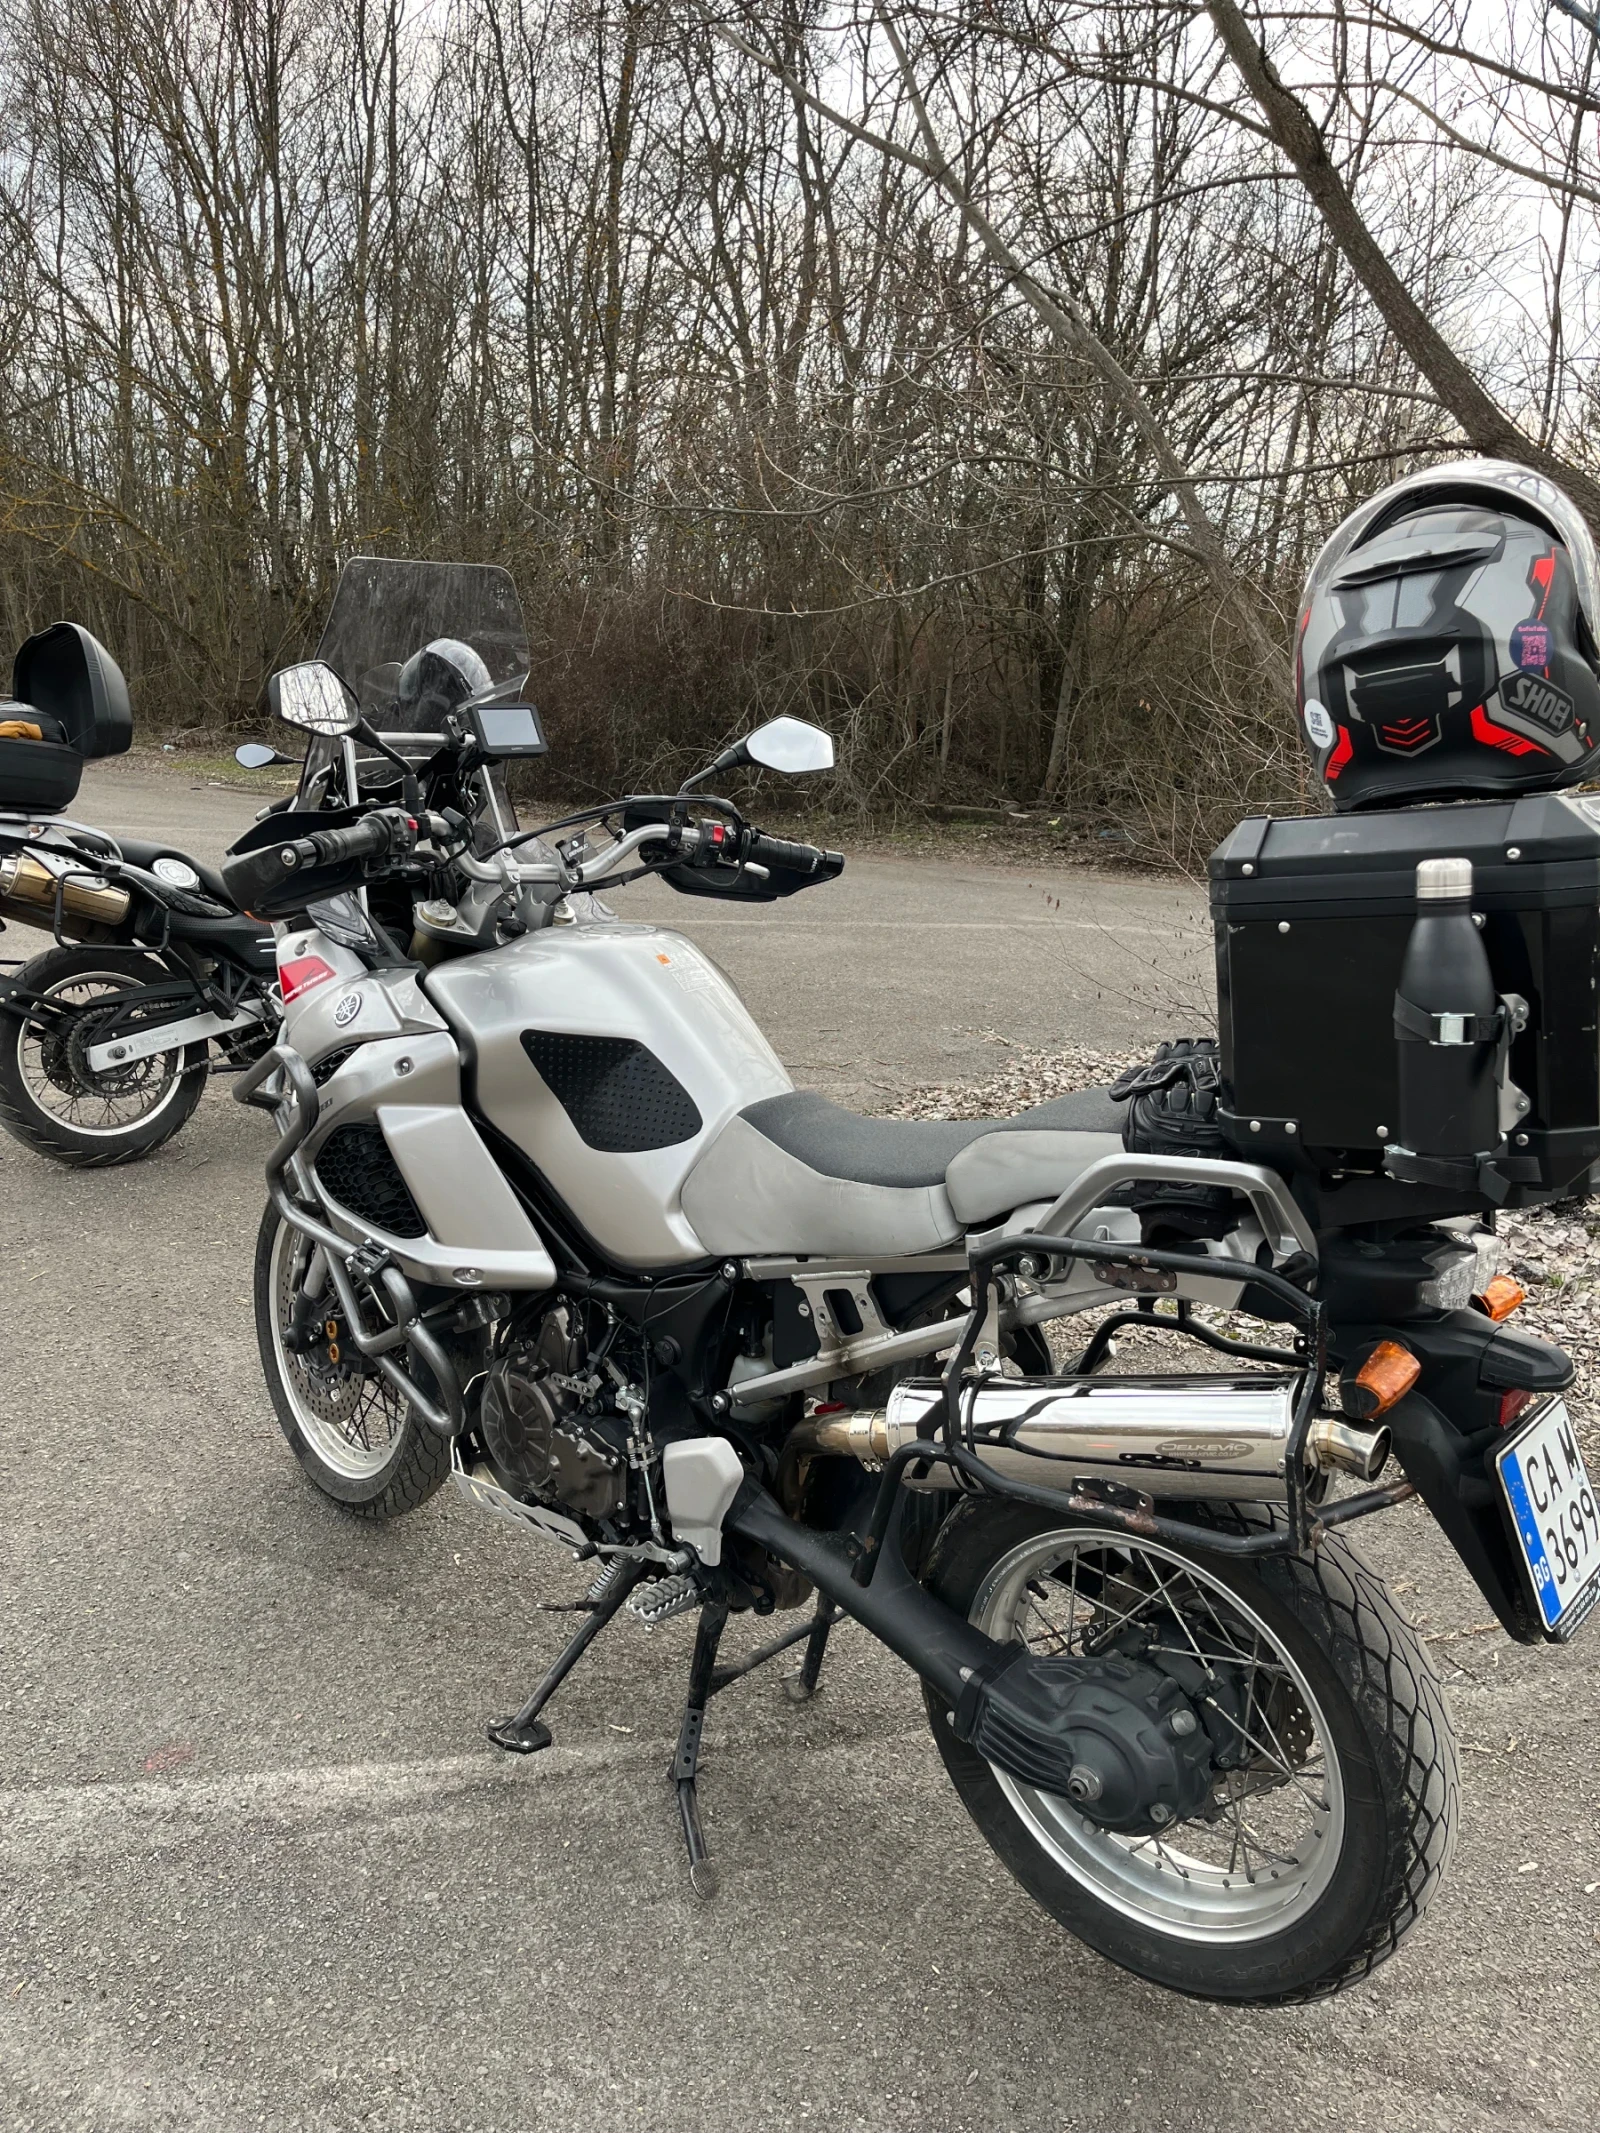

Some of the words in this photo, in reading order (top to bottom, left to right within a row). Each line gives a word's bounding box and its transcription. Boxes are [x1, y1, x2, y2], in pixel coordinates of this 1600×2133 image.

[1509, 677, 1571, 729] SHOEI
[1526, 1443, 1563, 1513] CA
[1556, 1419, 1581, 1480] M
[1546, 1487, 1599, 1585] 3699
[1533, 1555, 1550, 1591] BG
